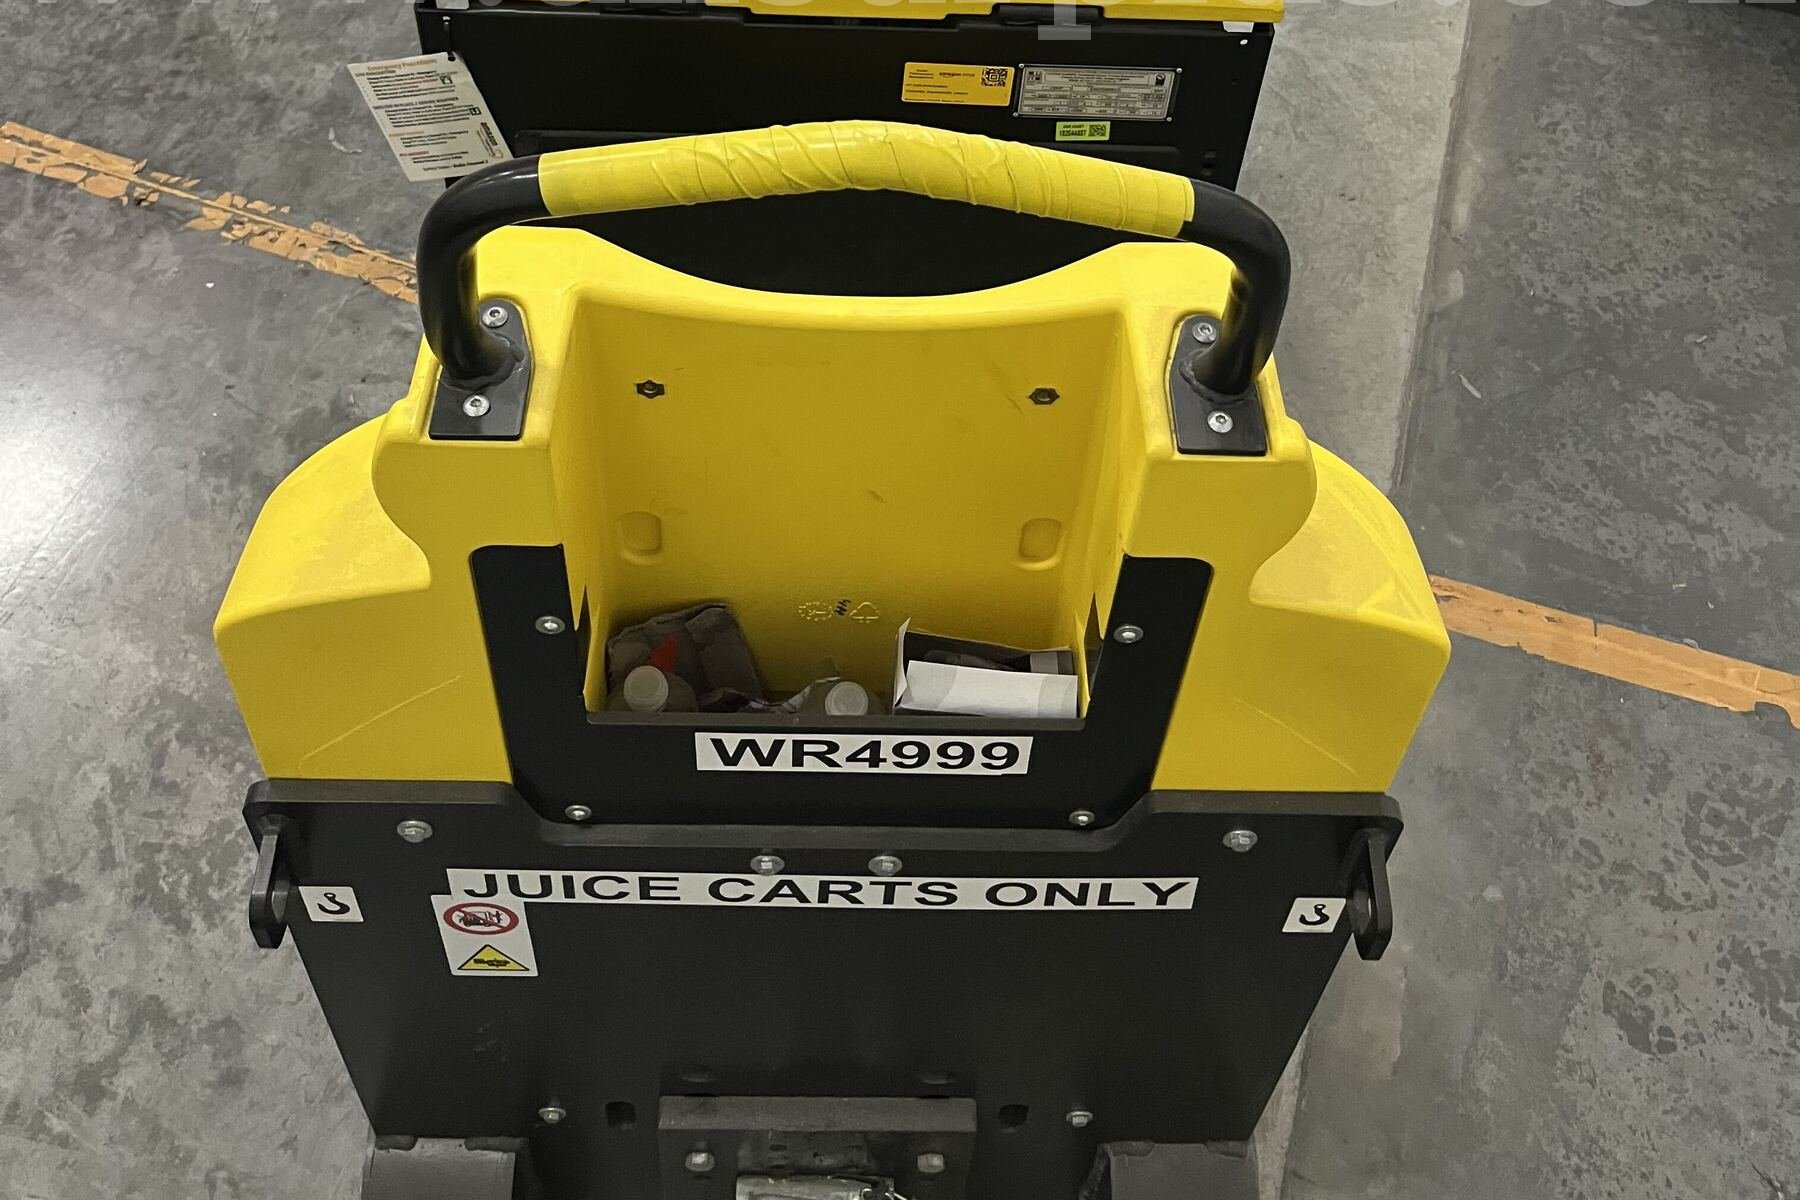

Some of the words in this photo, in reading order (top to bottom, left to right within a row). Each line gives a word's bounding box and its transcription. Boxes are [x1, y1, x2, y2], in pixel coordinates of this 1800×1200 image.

[709, 737, 1020, 771] WR4999
[463, 873, 681, 901] JUICE
[708, 877, 958, 907] CARTS
[985, 882, 1190, 907] ONLY
